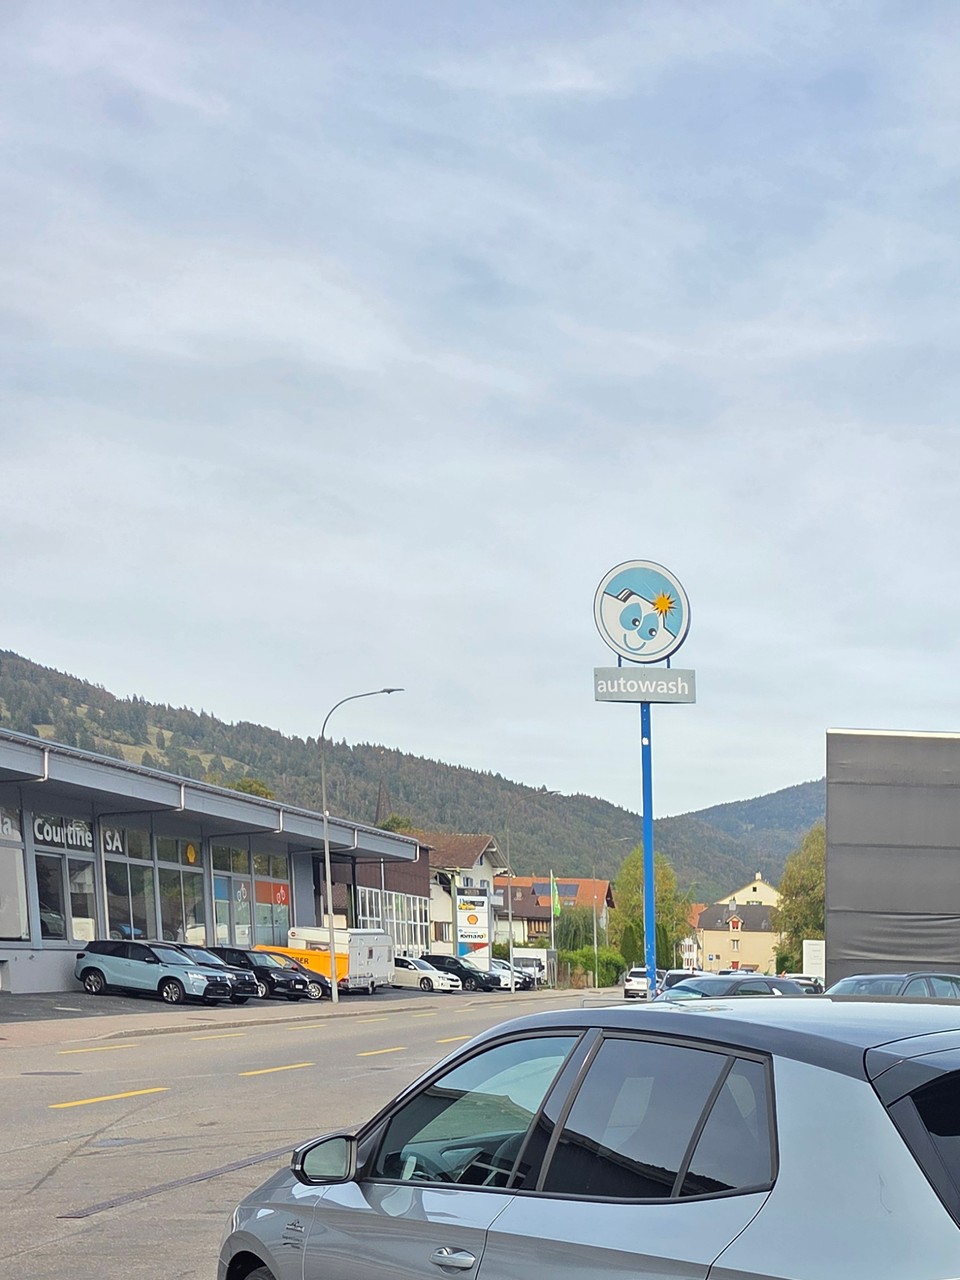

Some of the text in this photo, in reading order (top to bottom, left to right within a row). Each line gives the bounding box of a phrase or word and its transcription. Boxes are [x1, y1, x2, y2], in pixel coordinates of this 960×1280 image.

[597, 677, 689, 695] autowash
[34, 818, 93, 848] Courtine
[105, 830, 123, 852] SA
